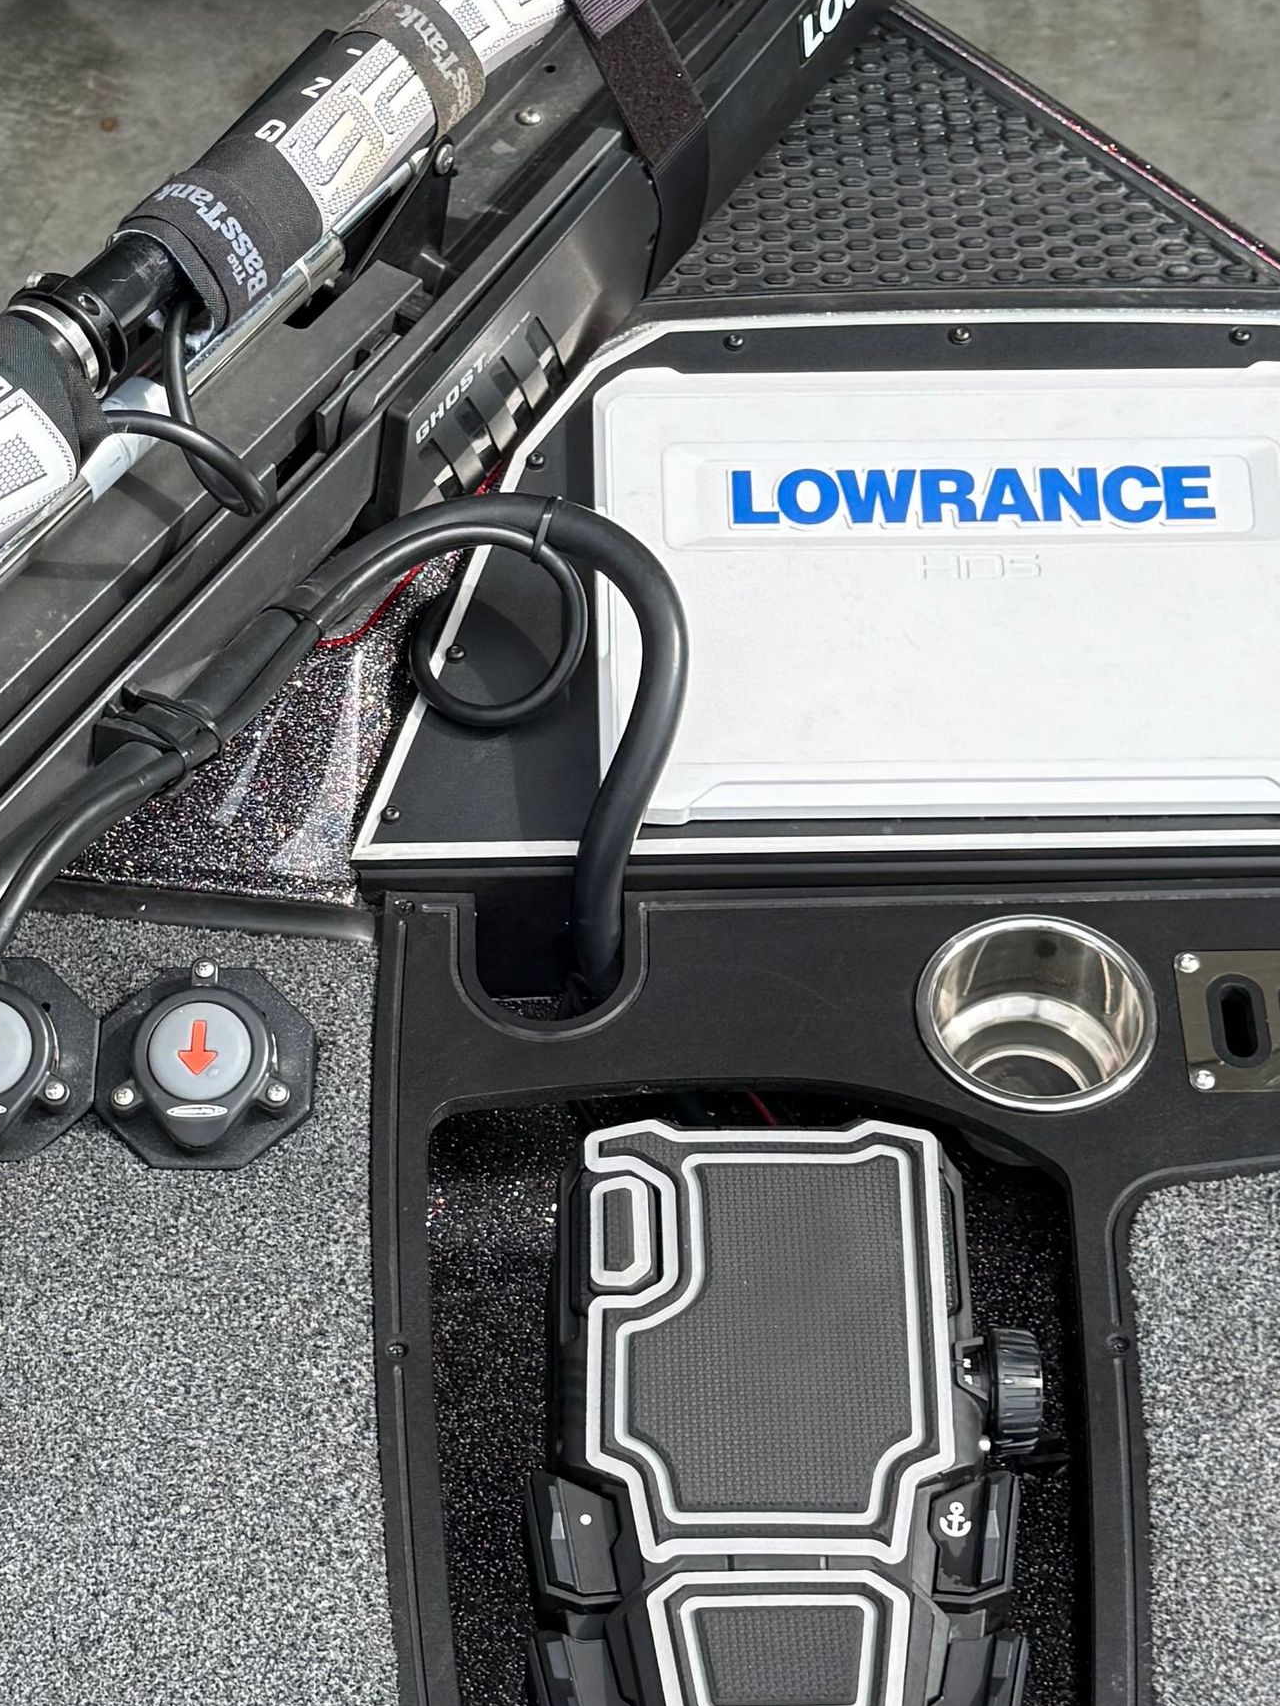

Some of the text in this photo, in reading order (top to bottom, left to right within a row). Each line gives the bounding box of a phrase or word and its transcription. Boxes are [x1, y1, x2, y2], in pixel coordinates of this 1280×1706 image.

[153, 183, 268, 301] BassTank
[415, 352, 487, 444] GHOST
[730, 464, 1218, 529] LOWRANCE
[920, 552, 1043, 580] HDS
